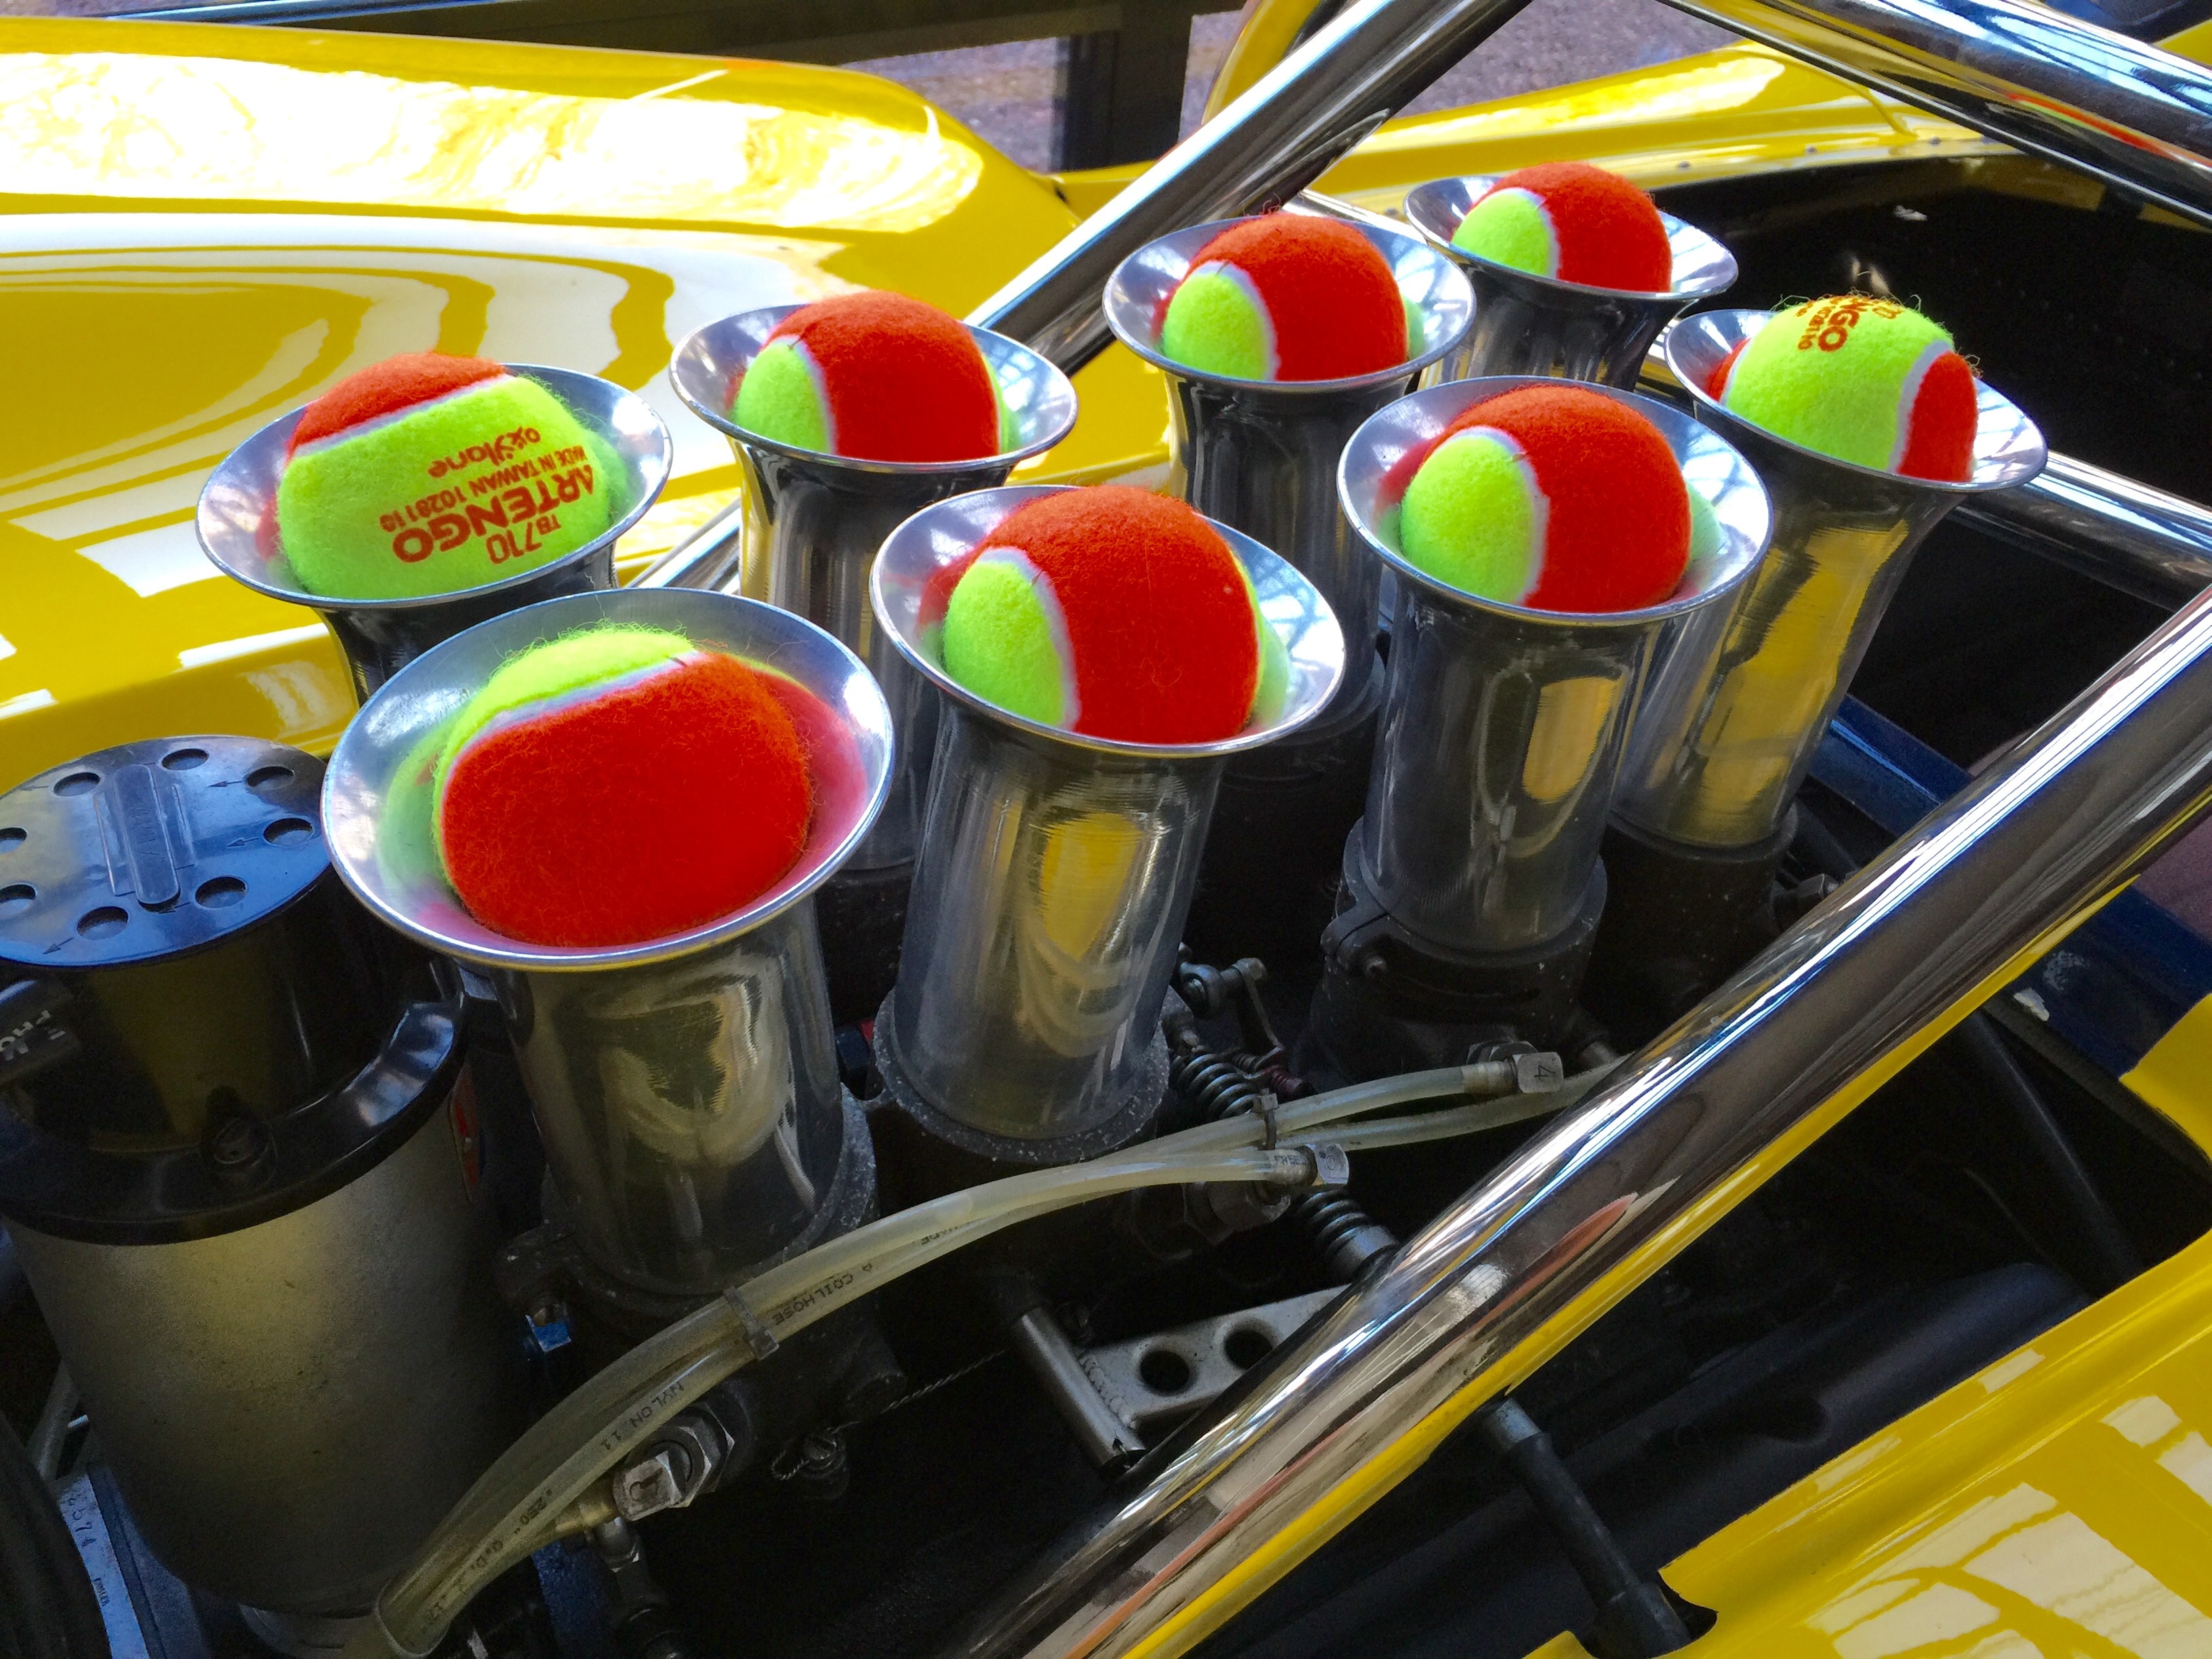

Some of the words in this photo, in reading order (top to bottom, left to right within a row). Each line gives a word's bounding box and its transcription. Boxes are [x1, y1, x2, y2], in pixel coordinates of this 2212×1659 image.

[537, 453, 556, 471] IN
[555, 445, 588, 468] MADE
[468, 459, 541, 497] TAIWAN
[392, 464, 594, 563] ARTENGO
[536, 514, 561, 535] TB
[486, 522, 542, 565] 710
[771, 1272, 854, 1326] COILHOSE
[630, 1381, 685, 1432] NYLON
